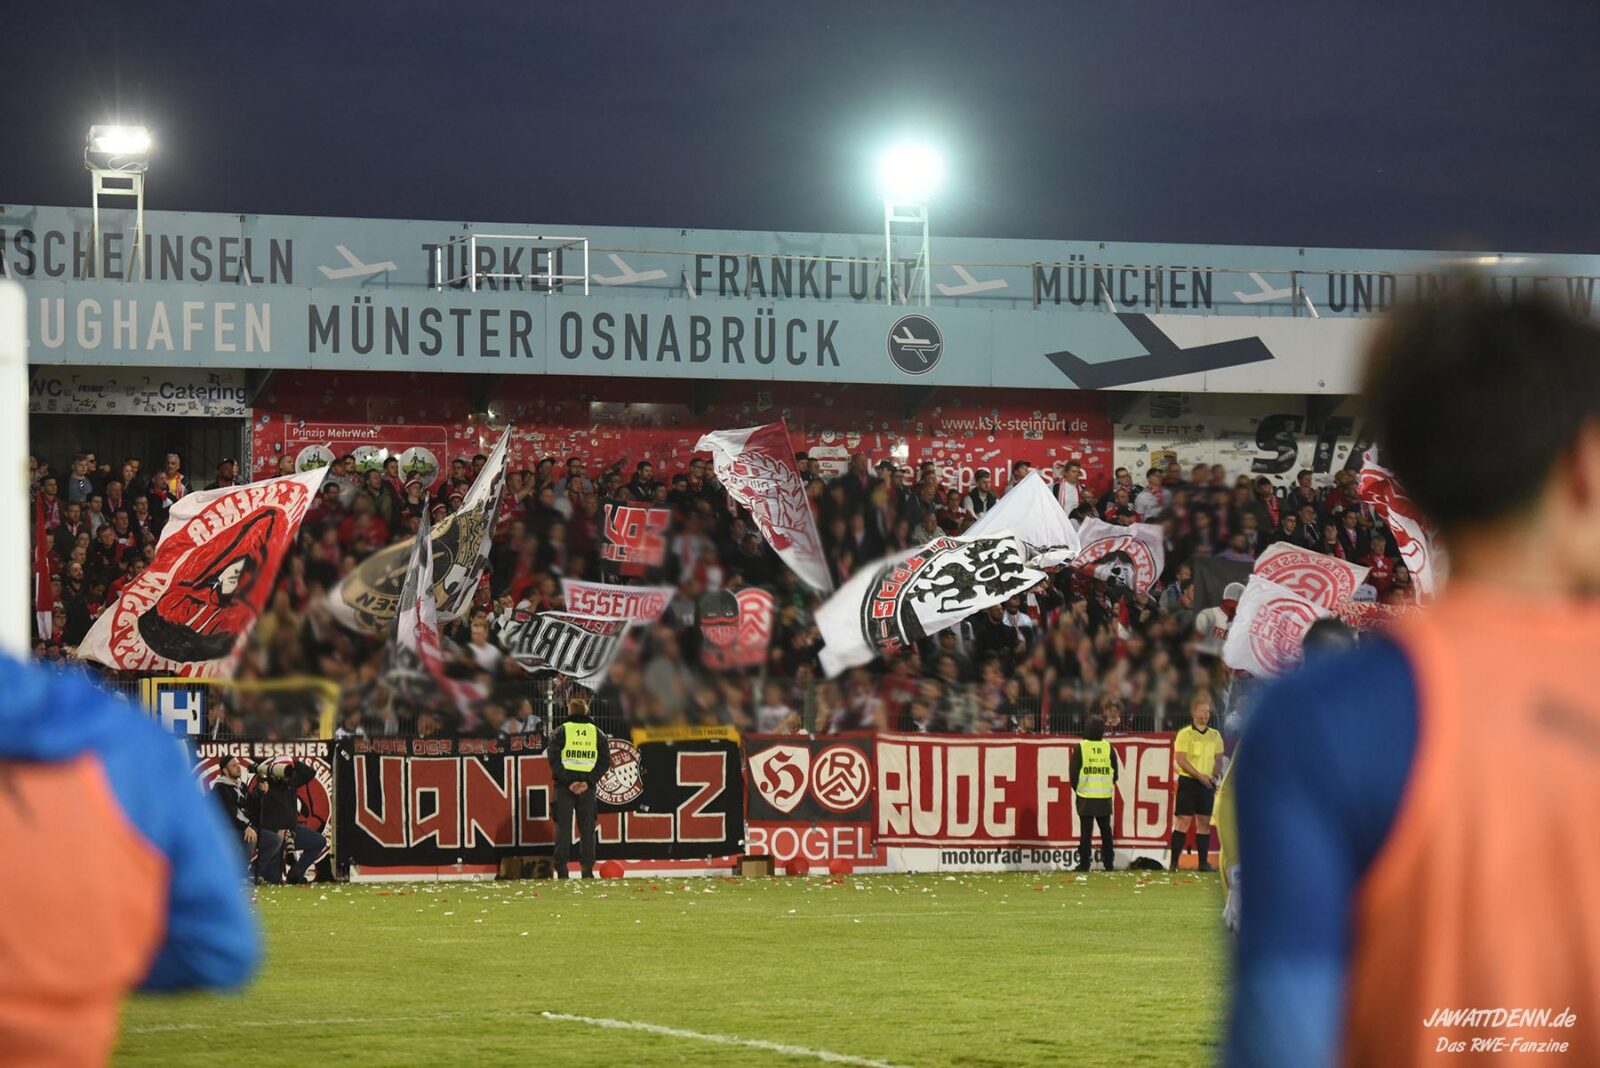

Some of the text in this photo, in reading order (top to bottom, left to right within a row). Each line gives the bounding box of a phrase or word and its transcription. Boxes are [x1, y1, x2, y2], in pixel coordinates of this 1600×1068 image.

[145, 234, 293, 284] INSELN
[422, 236, 563, 292] TÜRKEI
[695, 253, 923, 301] FRANKFURT
[1033, 255, 1213, 309] MÜNCHEN
[1328, 274, 1397, 313] UND
[27, 296, 841, 367] UGHAFEN MÜNSTER OSNABRÜCK
[160, 382, 247, 404] Catering
[293, 427, 325, 439] Prinzip
[941, 416, 1088, 432] www.ksk-steinfurt.de
[1139, 425, 1192, 434] SEAT
[196, 743, 328, 758] JUNGE ESSENER
[565, 750, 596, 759] ORDNER
[1083, 766, 1110, 774] ORDNER
[877, 743, 1170, 838] RUDE FNS
